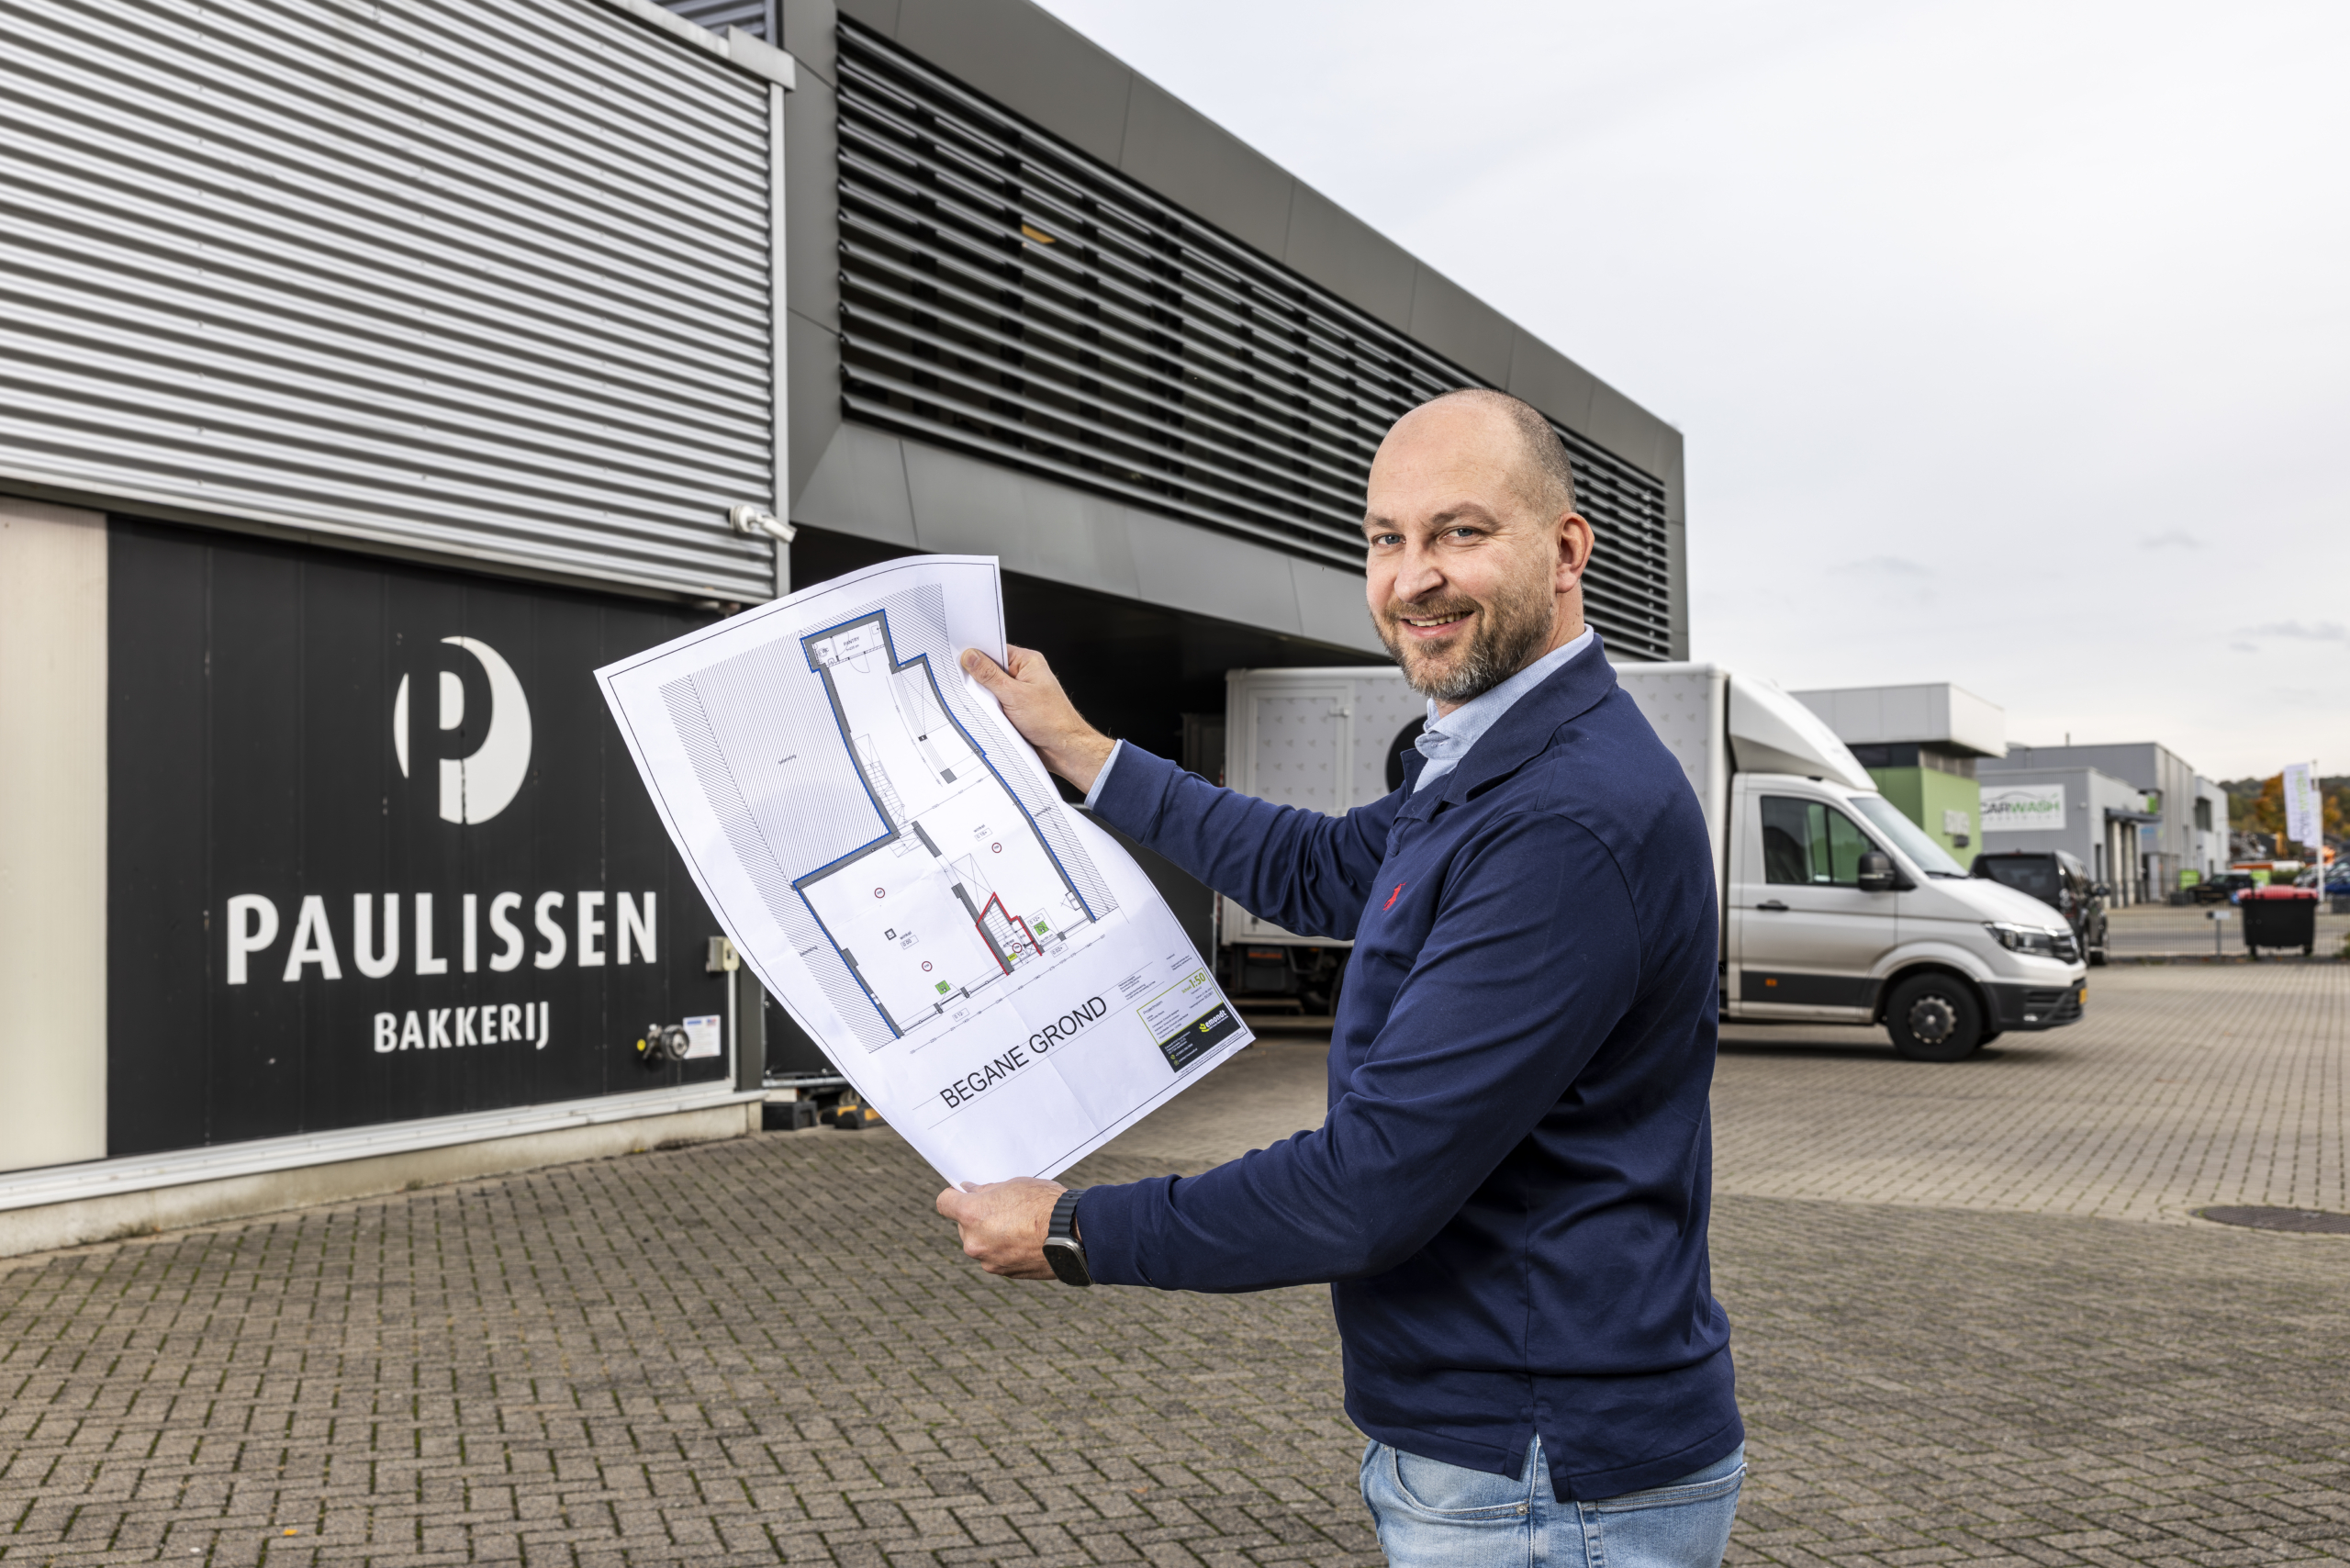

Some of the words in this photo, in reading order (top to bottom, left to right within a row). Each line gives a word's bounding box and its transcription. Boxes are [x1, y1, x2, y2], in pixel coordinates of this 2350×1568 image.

[227, 890, 657, 985] PAULISSEN
[1189, 972, 1206, 989] 1:50
[375, 1002, 550, 1053] BAKKERIJ
[1205, 1010, 1227, 1028] emondt
[939, 1045, 1030, 1109] BEGANE
[1029, 996, 1107, 1054] GROND
